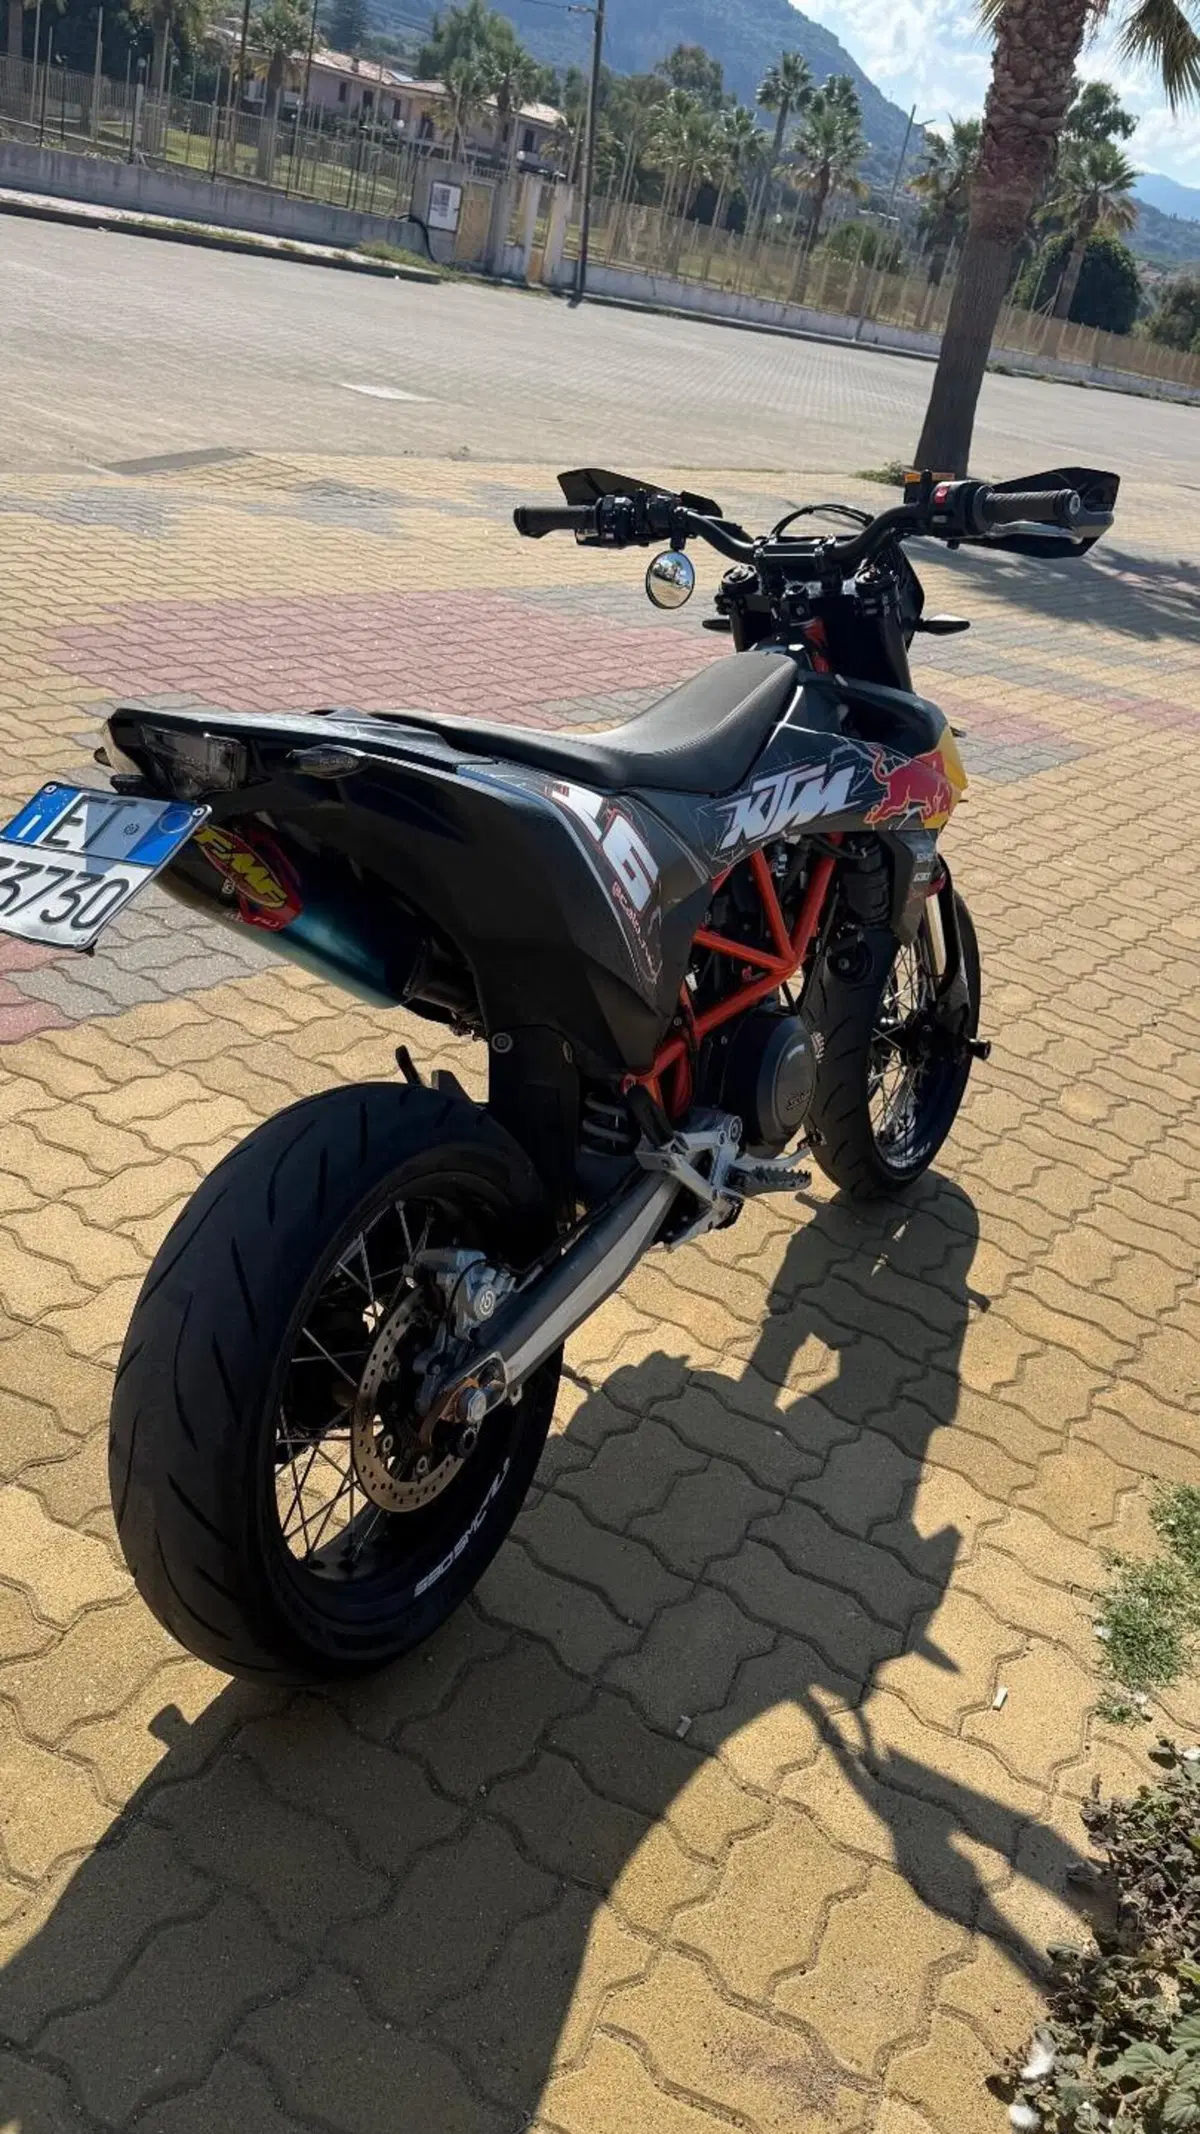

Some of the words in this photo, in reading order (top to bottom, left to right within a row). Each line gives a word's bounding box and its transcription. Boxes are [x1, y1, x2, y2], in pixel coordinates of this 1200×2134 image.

[715, 764, 863, 850] KTM
[0, 856, 129, 930] 3730
[192, 825, 288, 901] FMF
